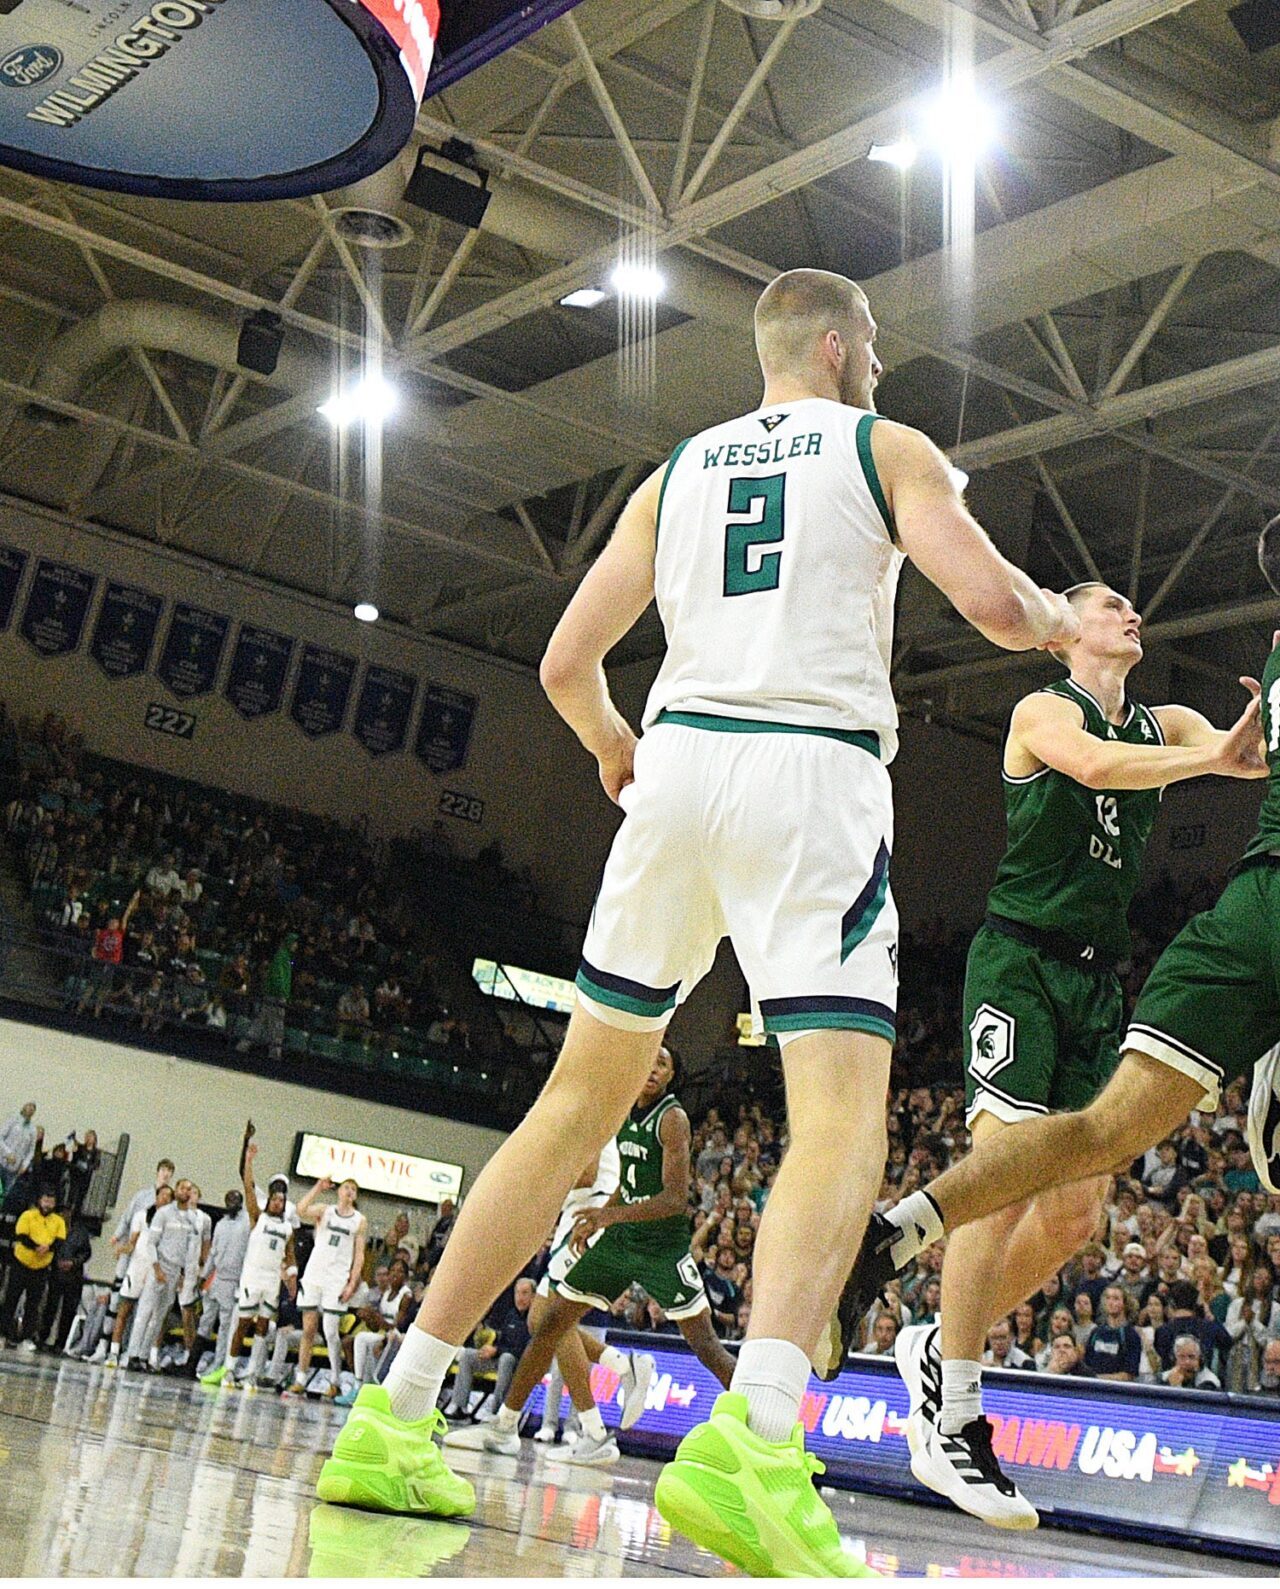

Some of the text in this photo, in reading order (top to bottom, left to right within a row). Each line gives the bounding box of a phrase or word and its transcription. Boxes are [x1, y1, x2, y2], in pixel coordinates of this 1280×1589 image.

[3, 51, 54, 84] Ford
[703, 432, 823, 470] WESSLER
[722, 471, 787, 598] 2
[147, 705, 194, 736] 227
[440, 791, 482, 821] 228
[1095, 795, 1121, 837] 12
[619, 1140, 649, 1161] OUNT
[821, 1395, 887, 1443] USA
[1078, 1425, 1158, 1482] USA
